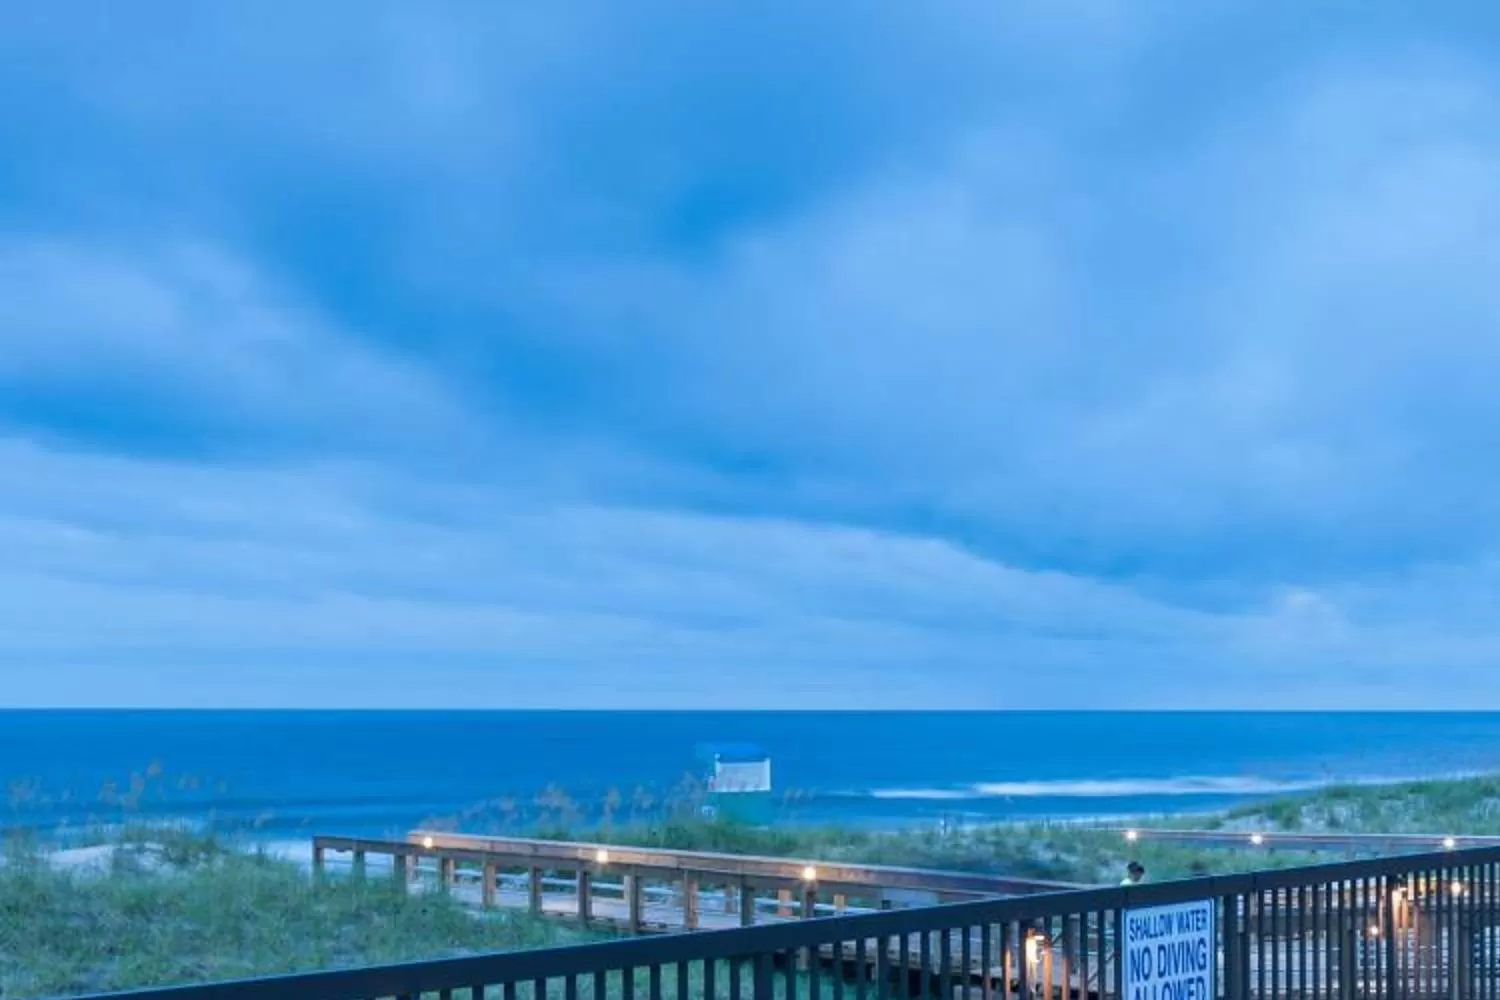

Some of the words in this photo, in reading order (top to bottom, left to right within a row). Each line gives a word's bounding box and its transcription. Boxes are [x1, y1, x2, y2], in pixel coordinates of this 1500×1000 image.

[1129, 912, 1172, 942] SHALLOW
[1176, 908, 1207, 935] WATER
[1130, 946, 1152, 984] NO
[1157, 937, 1207, 978] DIVING
